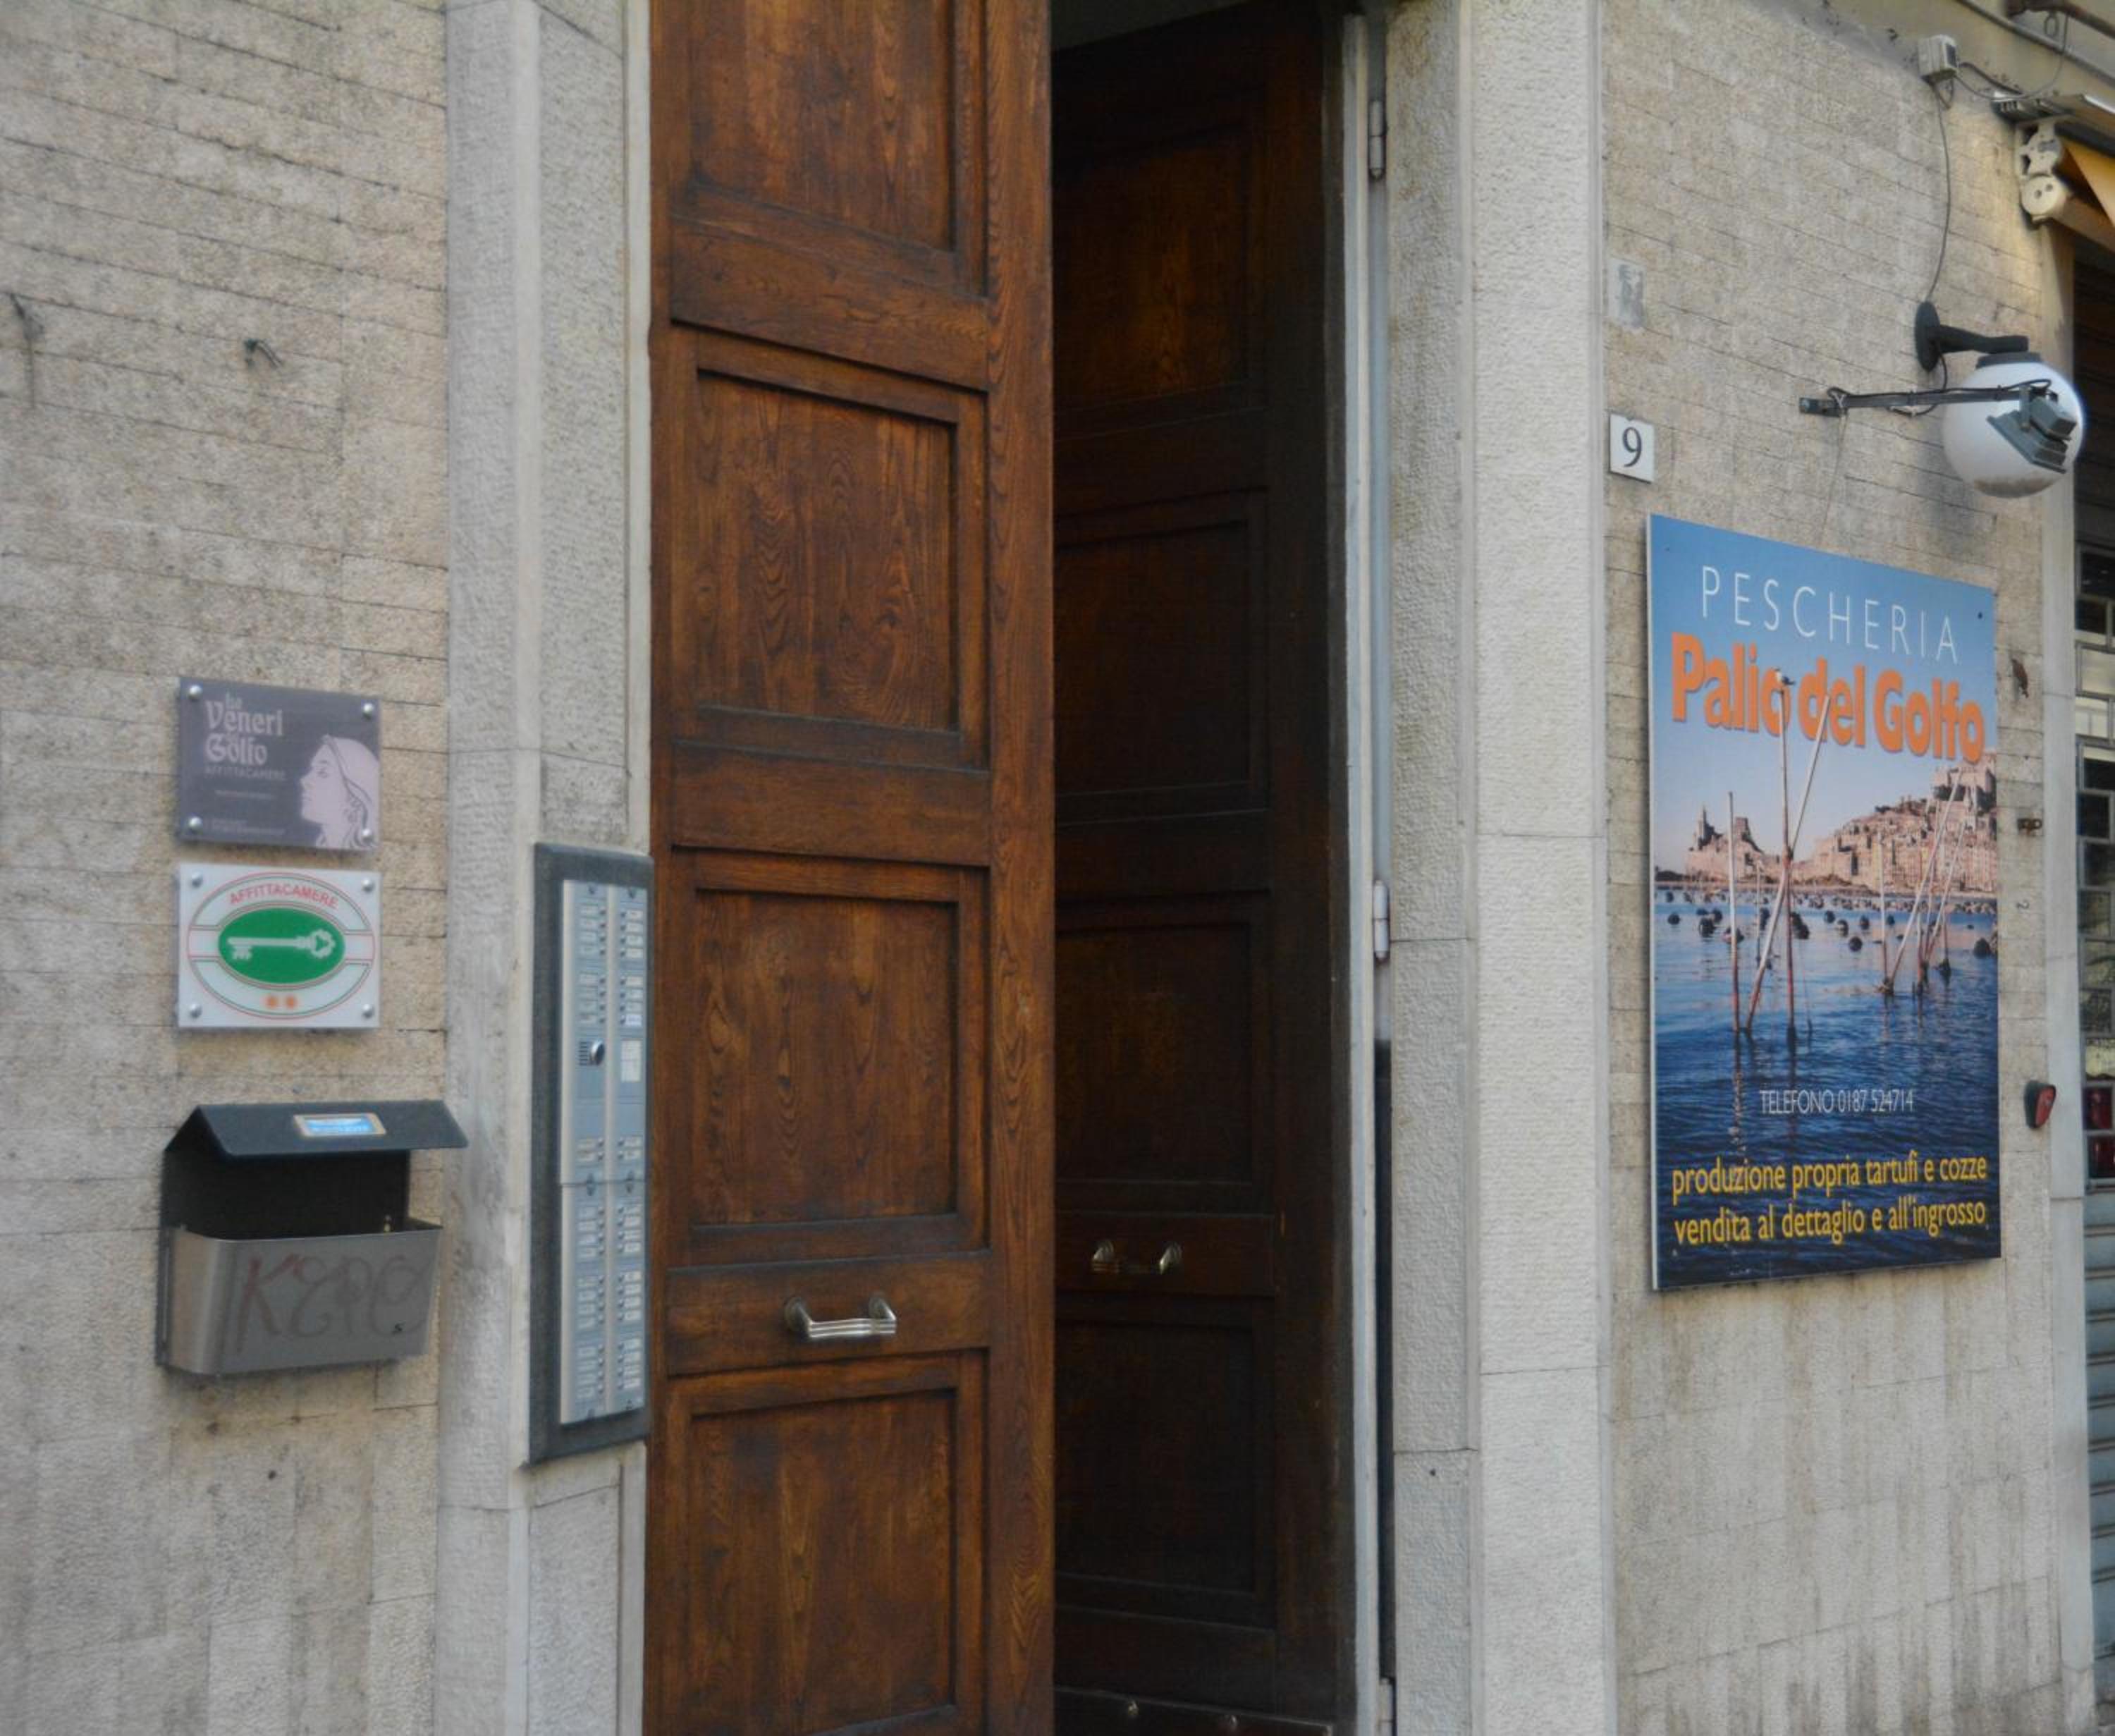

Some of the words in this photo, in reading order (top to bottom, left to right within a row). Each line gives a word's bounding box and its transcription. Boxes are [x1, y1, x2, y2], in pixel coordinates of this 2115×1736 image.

[1622, 427, 1643, 467] 9
[1701, 565, 1959, 665] PESCHERIA
[1671, 631, 1791, 738] Palio
[1798, 655, 1866, 748] del
[1874, 668, 1985, 764] Golfo
[229, 883, 339, 910] AFFITTACAMERE
[1759, 1089, 1834, 1114] TELEFONO
[1837, 1089, 1868, 1113] 0187
[1870, 1088, 1913, 1113] 524714
[1671, 1157, 1786, 1206] produzione
[1791, 1155, 1860, 1198] propria
[1866, 1150, 1918, 1185] tartufi
[1923, 1160, 1935, 1181] e
[1939, 1155, 1987, 1182] cozze
[1674, 1206, 1751, 1246] vendita
[1758, 1203, 1775, 1240] al
[1781, 1199, 1865, 1246] dettaglio
[1872, 1209, 1883, 1231] e
[1888, 1196, 1986, 1238] all'ingrosso
